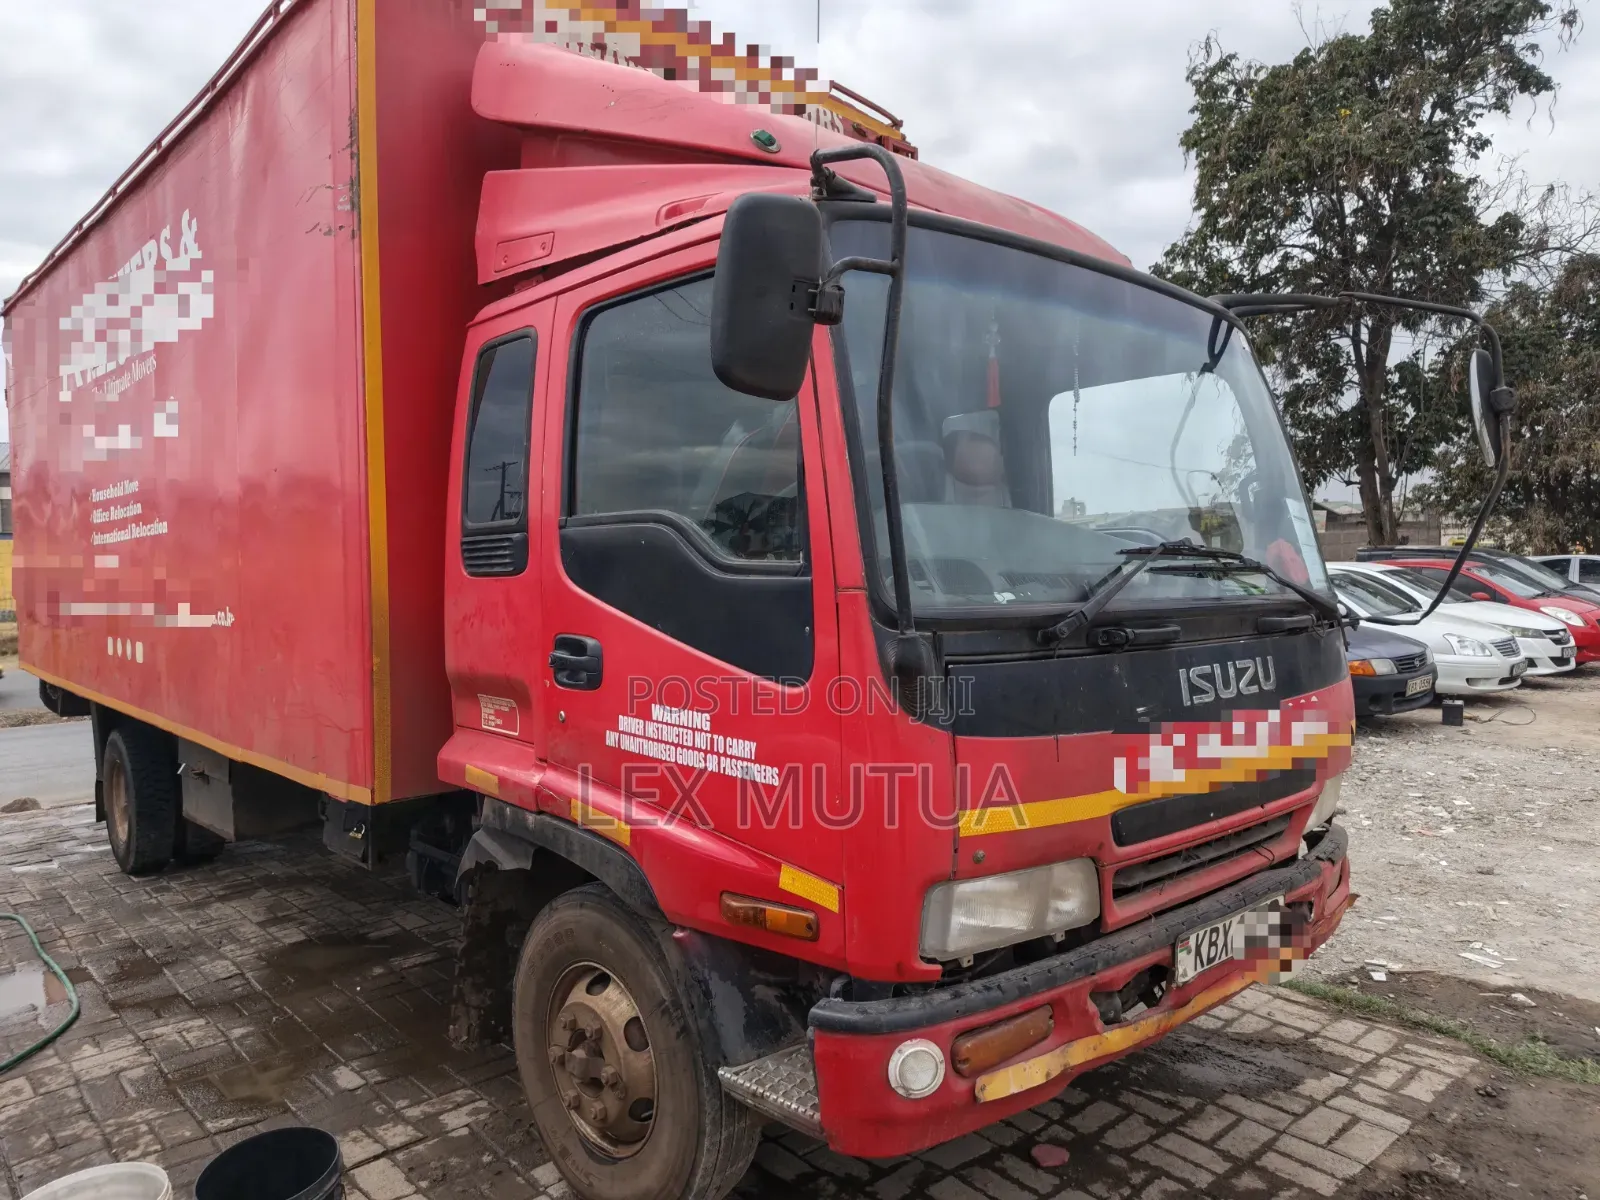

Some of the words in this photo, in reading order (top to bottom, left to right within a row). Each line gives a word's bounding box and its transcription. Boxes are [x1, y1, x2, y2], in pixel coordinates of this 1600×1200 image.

[132, 353, 157, 384] Movers
[92, 482, 124, 502] Household
[124, 480, 139, 495] Move
[92, 508, 110, 524] Office
[110, 500, 142, 520] Relocation
[93, 524, 131, 546] International
[131, 517, 168, 538] Relocation
[1179, 656, 1276, 706] ISUZU
[651, 703, 711, 731] WARNING
[618, 715, 645, 736] DRIVER
[645, 720, 693, 746] INSTRUCTED
[695, 731, 712, 751] NOT
[713, 734, 724, 754] TO
[726, 737, 757, 760] CARRY
[605, 730, 620, 748] ANY
[620, 733, 676, 762] UNAUTHORISED
[676, 747, 705, 769] GOODS
[706, 753, 719, 773] OR
[720, 756, 779, 786] PASSENGERS
[1194, 920, 1232, 972] KBX
